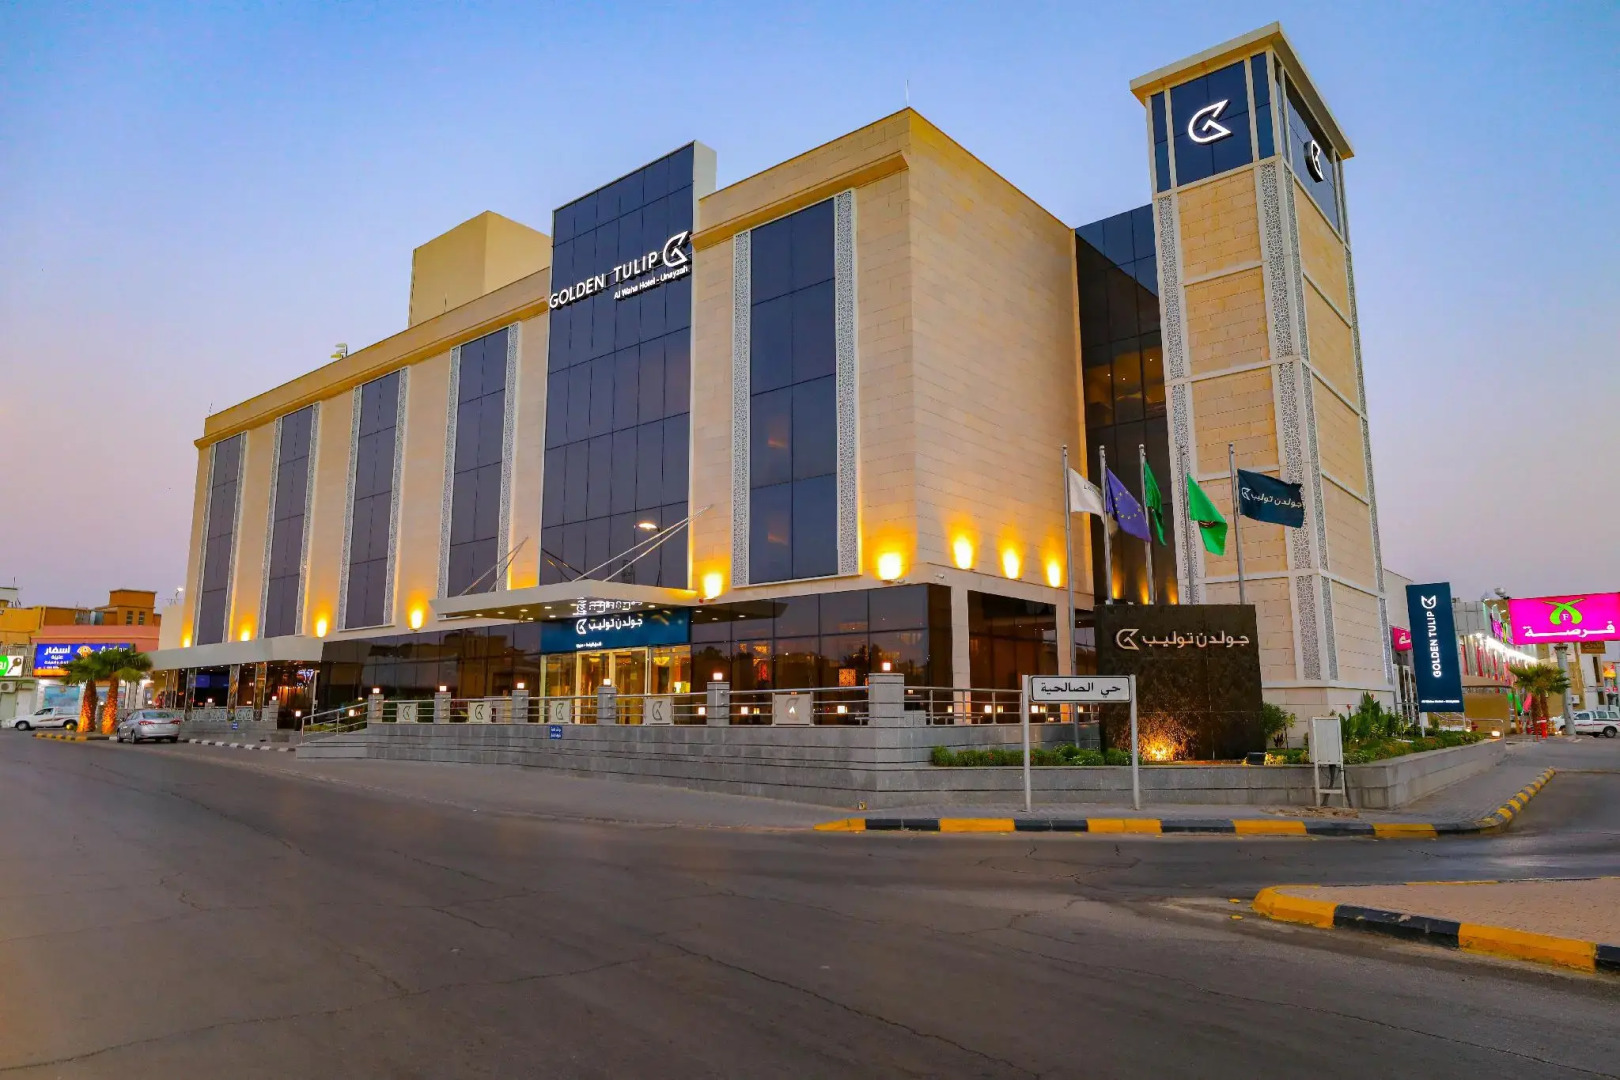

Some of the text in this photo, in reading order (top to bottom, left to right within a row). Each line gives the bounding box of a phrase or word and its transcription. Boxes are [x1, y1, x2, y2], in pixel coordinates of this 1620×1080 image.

[549, 252, 658, 308] GOLDEN TULIP
[639, 276, 656, 290] Hotel
[588, 616, 643, 631] جولدن توليب
[1142, 630, 1250, 649] جولدن توليب
[1426, 611, 1442, 678] GOLDEN TULIP
[1040, 682, 1121, 698] حي الصالحية
